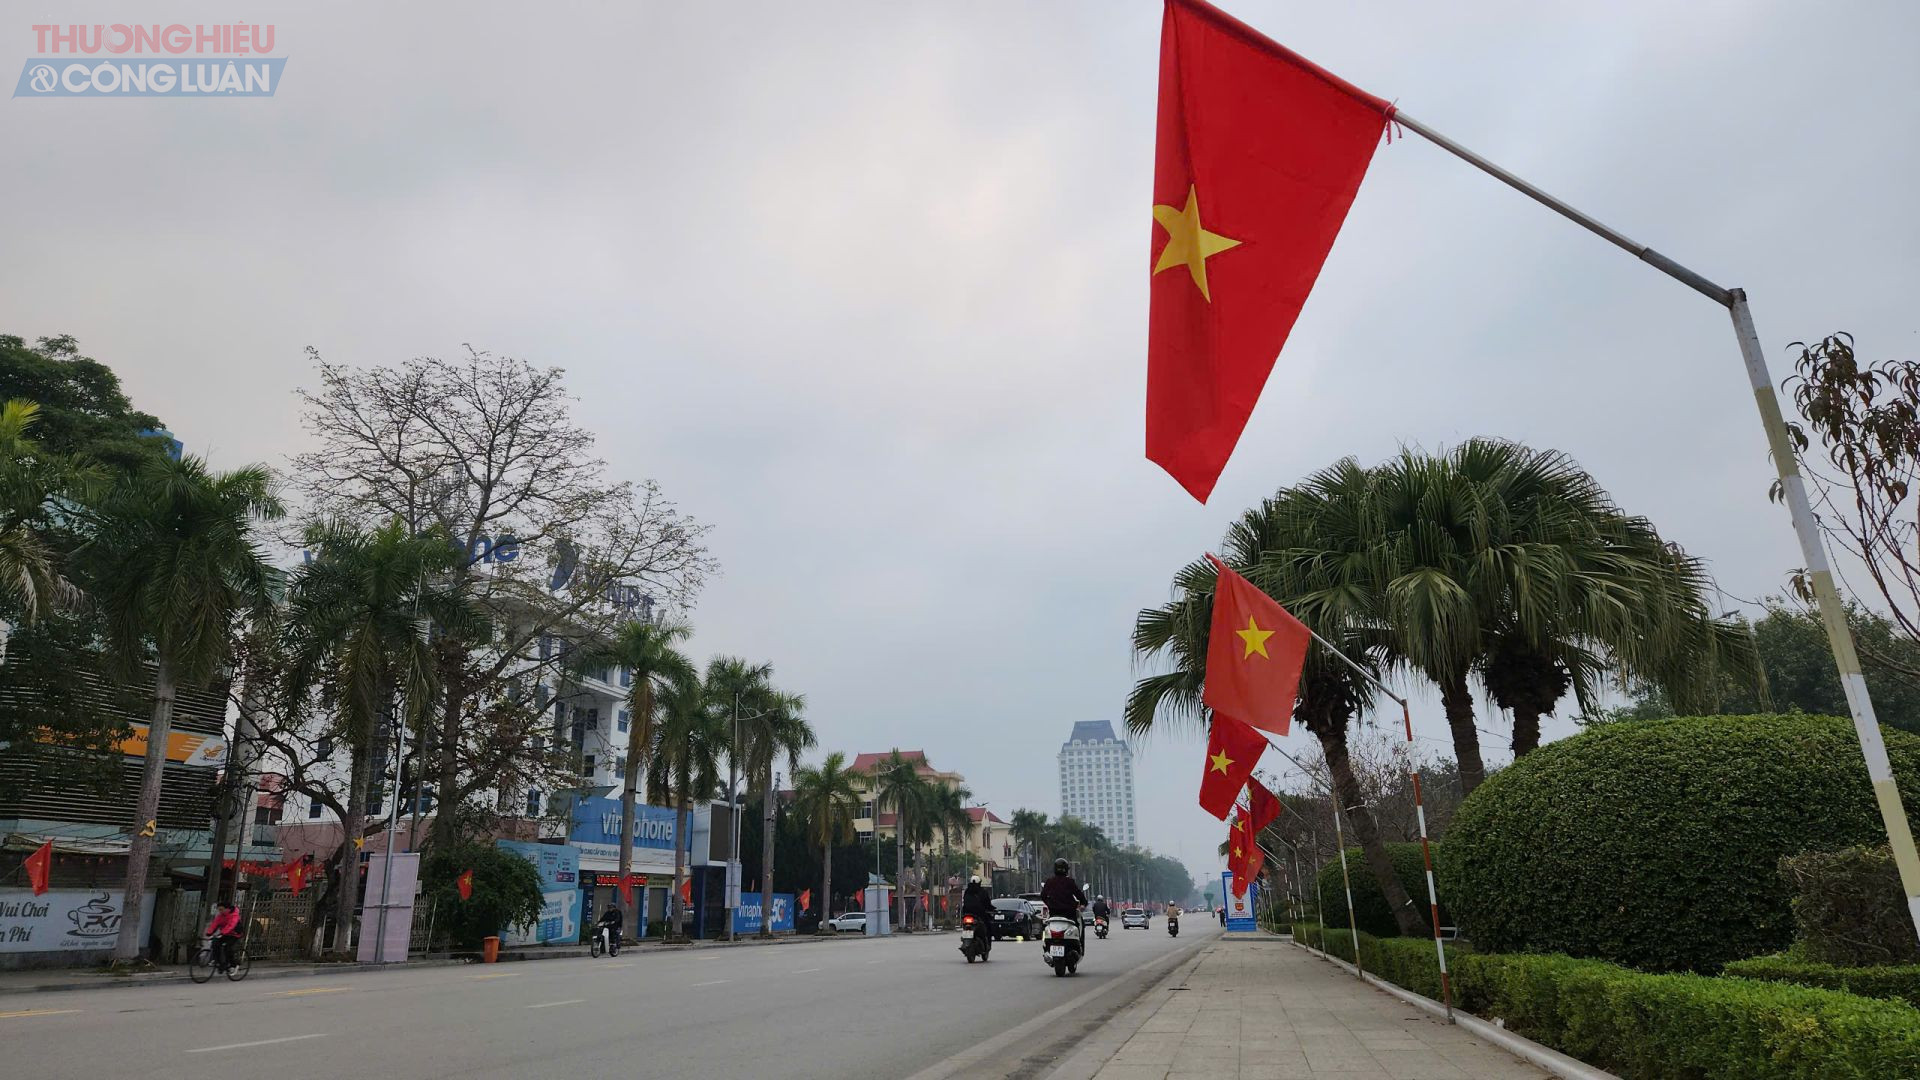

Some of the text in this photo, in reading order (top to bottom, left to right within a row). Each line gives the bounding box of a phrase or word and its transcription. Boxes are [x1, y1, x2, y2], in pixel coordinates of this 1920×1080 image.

[602, 808, 673, 841] vinphone
[738, 901, 763, 921] vinaph
[9, 925, 34, 942] Phí
